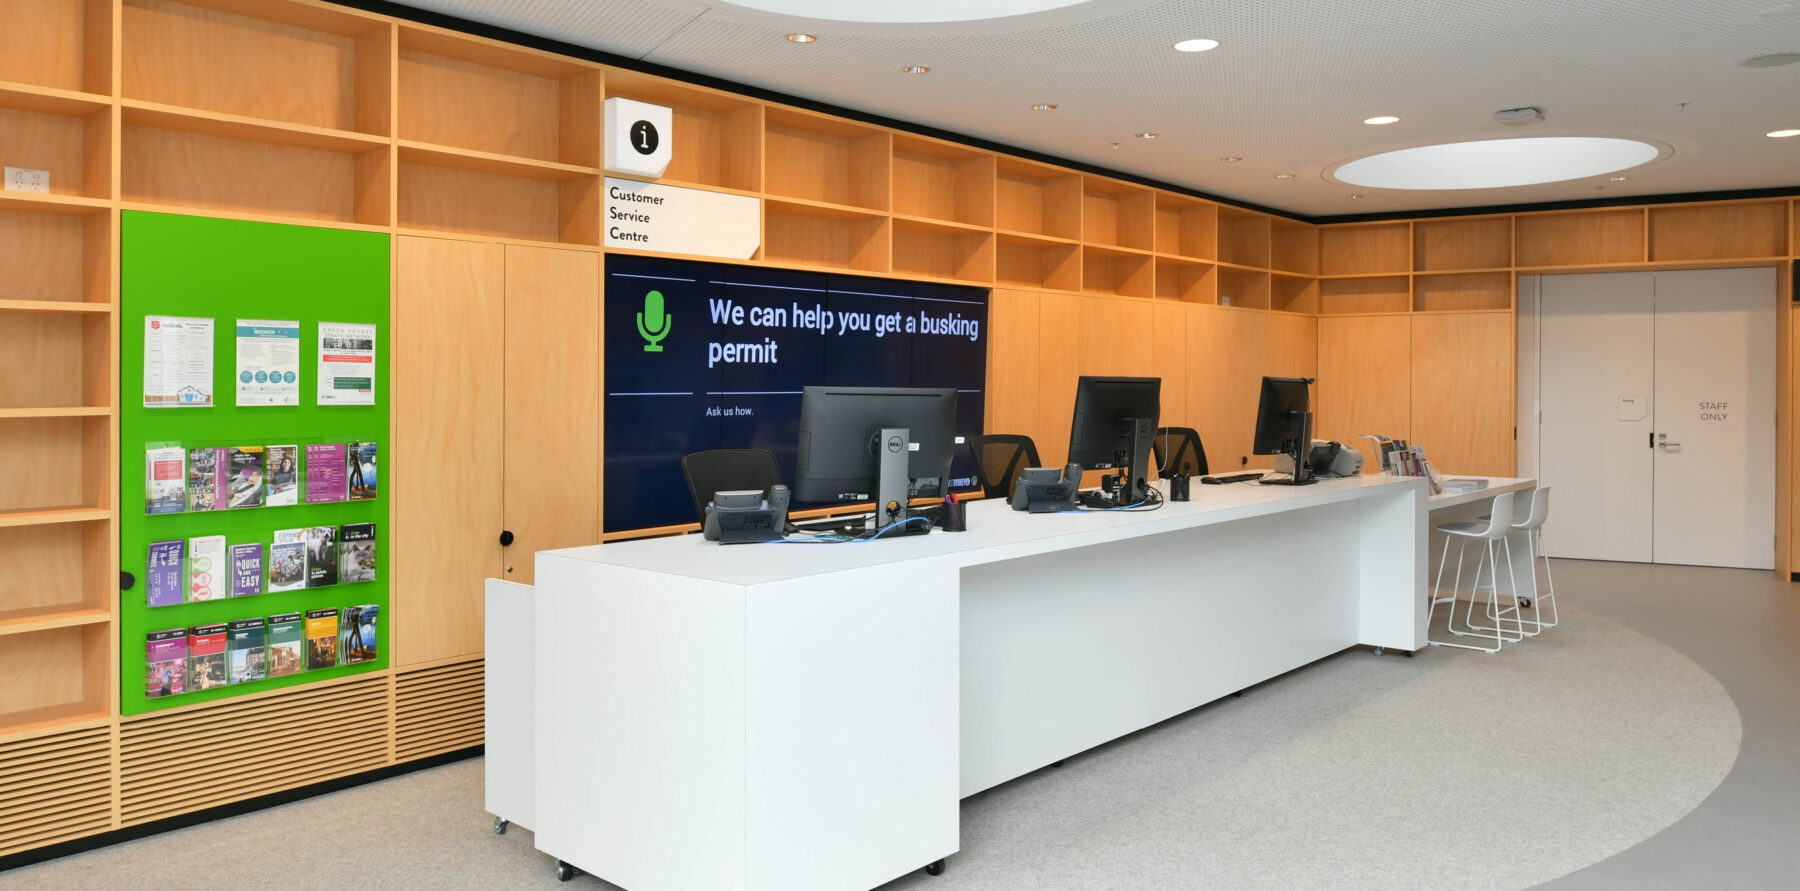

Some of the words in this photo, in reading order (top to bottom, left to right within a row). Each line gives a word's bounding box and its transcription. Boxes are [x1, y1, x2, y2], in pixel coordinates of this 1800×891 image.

[609, 186, 664, 205] Customer
[609, 206, 650, 223] Service
[609, 226, 649, 242] Centre
[709, 298, 745, 325] We
[749, 306, 787, 327] can
[792, 302, 834, 335] help
[838, 311, 871, 336] you
[875, 311, 902, 338] get
[905, 315, 916, 333] a
[920, 310, 979, 341] busking
[708, 337, 778, 368] permit
[706, 406, 722, 416] Ask
[723, 408, 734, 416] us
[735, 405, 754, 416] how.
[1699, 402, 1729, 410] STAFF
[1700, 412, 1728, 421] ONLY
[241, 558, 260, 570] QUICK
[241, 575, 260, 588] EASY
